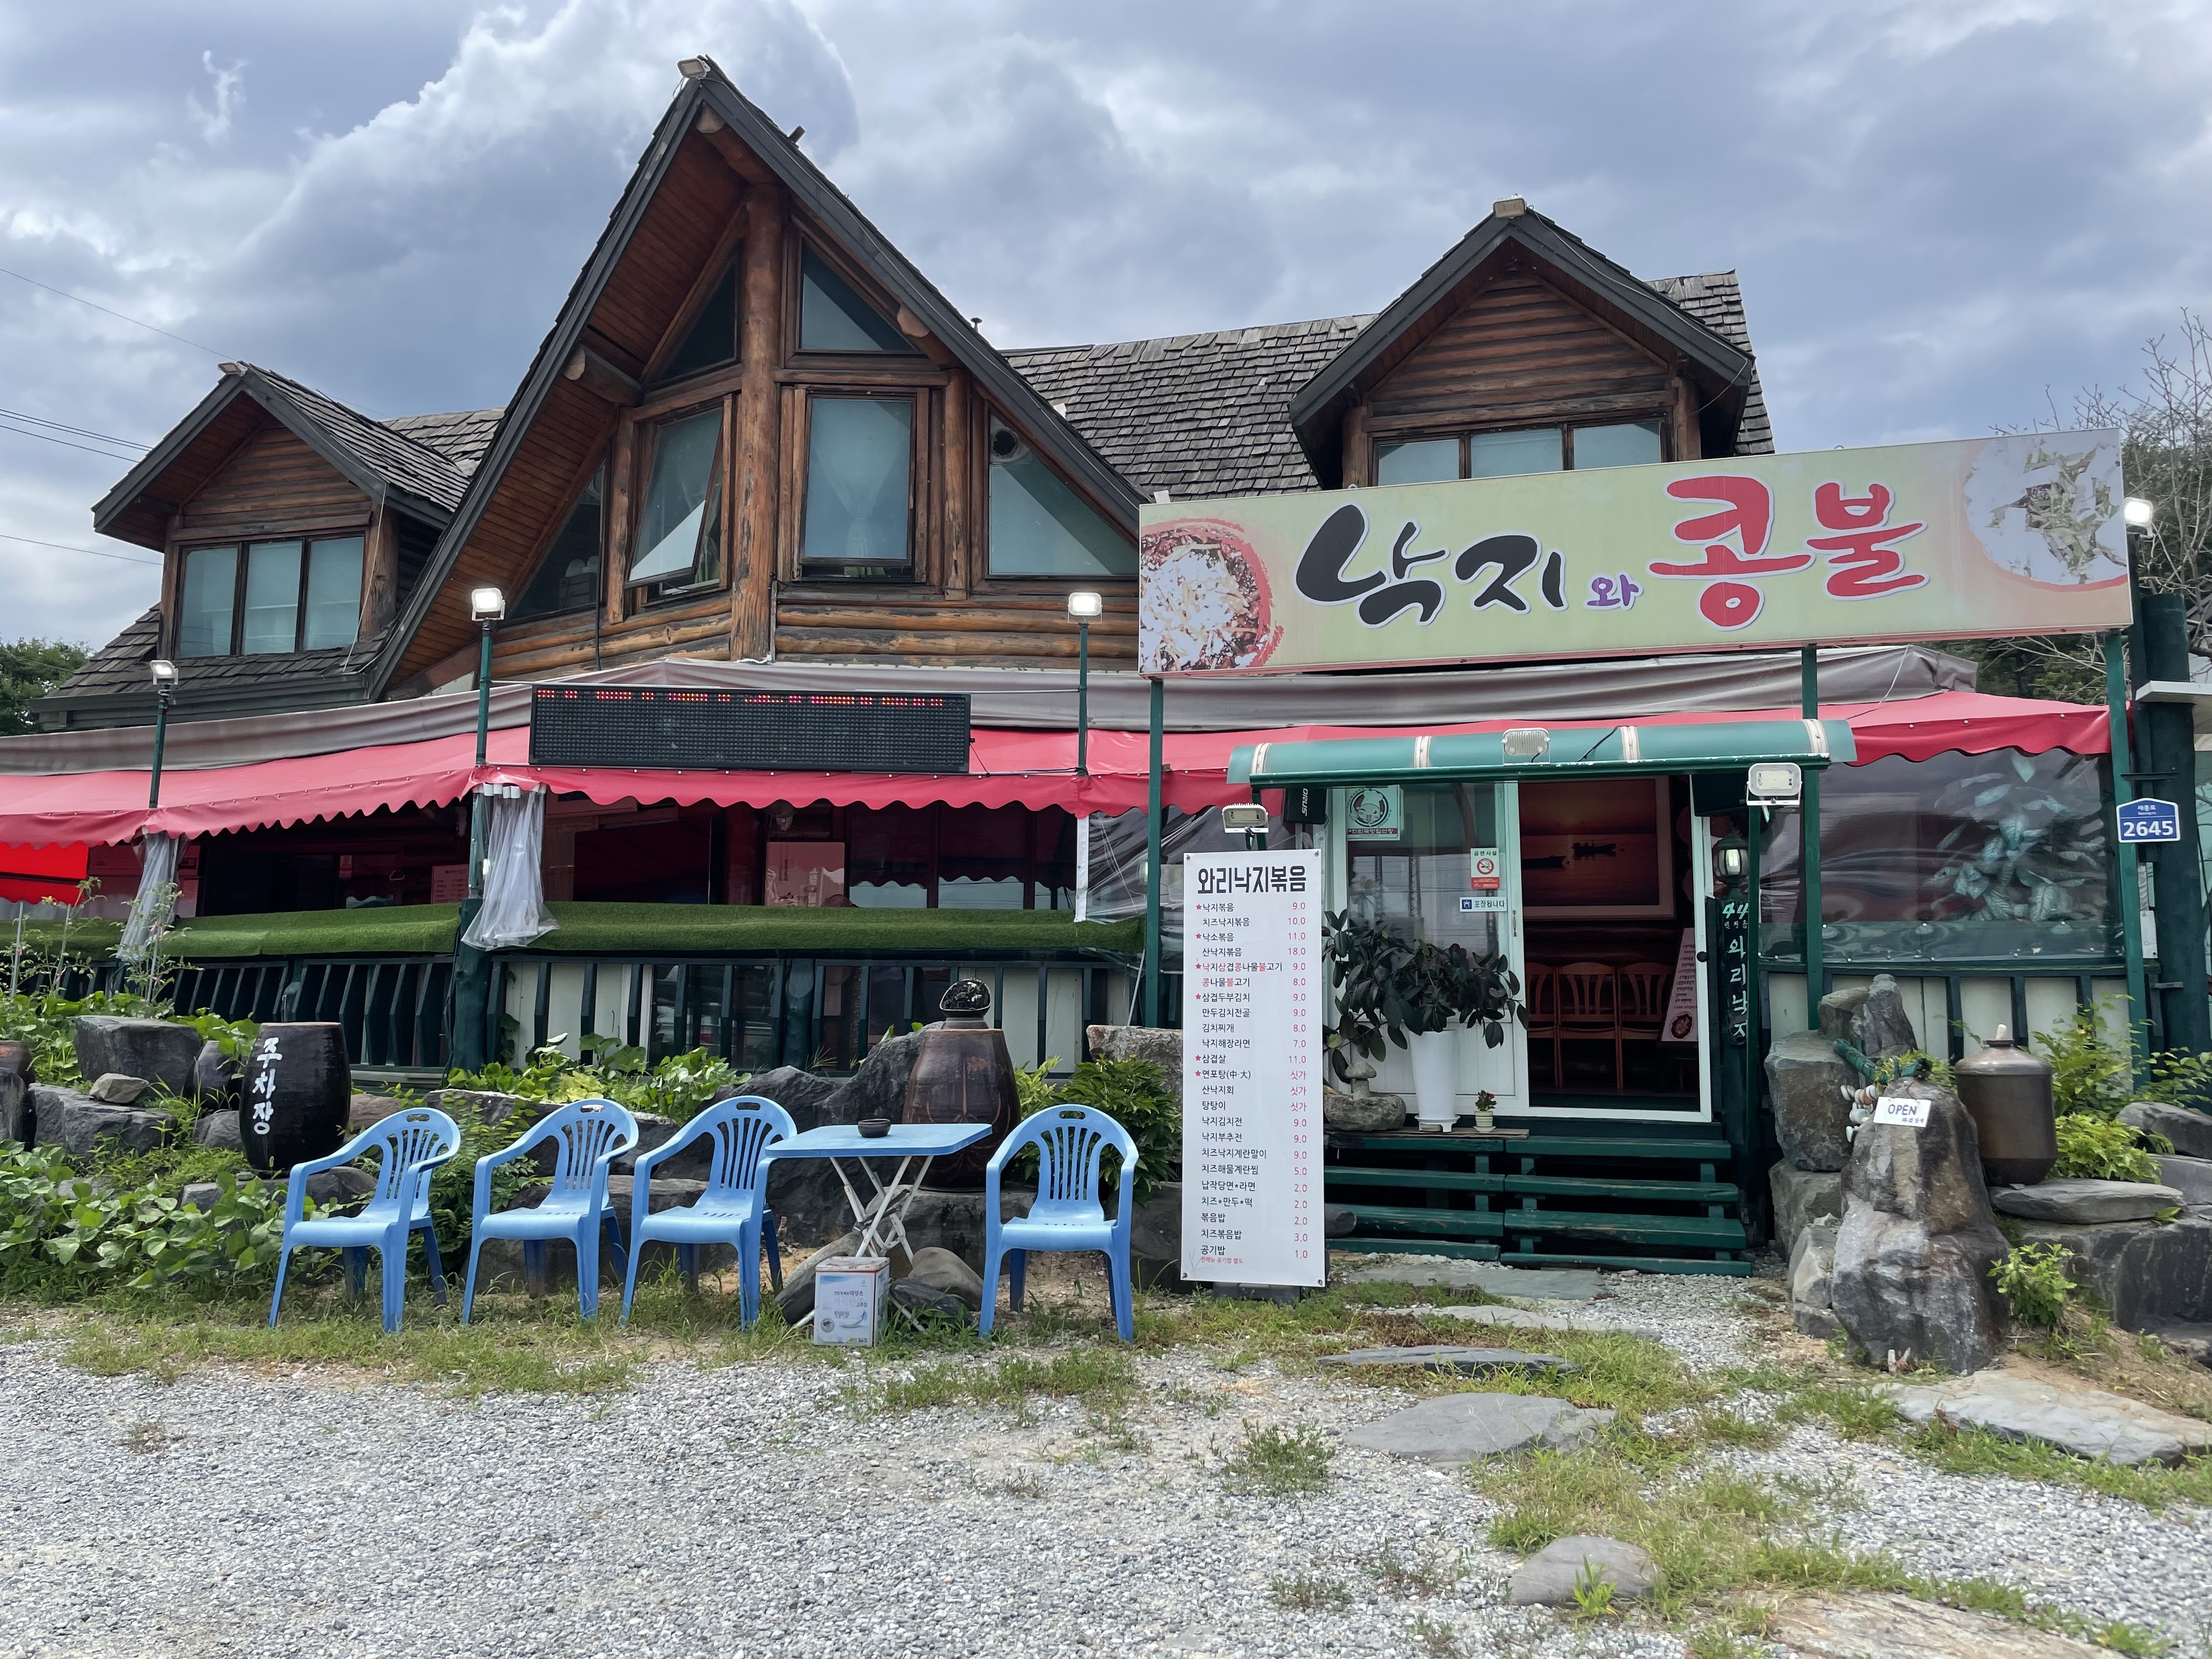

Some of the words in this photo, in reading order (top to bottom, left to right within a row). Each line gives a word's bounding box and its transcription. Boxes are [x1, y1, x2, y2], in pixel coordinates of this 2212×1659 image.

[1295, 504, 1565, 625] 낙지
[1587, 574, 1639, 607] 와
[1649, 475, 1925, 627] 콩불
[2123, 820, 2174, 837] 2645
[1198, 865, 1307, 894] 와리낙지볶음
[1203, 903, 1234, 912] 낙지볶음
[1474, 900, 1505, 908] 포장됩니다
[1722, 902, 1749, 919] 44
[1203, 918, 1250, 927] 치즈낙지볶음
[1203, 933, 1234, 942] 낙소볶음
[1203, 948, 1242, 957] 산낙지볶음
[1203, 962, 1282, 972] 낙지삼겹콩나물불고기
[1203, 978, 1250, 987] 콩나물불고기
[1728, 935, 1748, 1037] 와리낙지
[1202, 993, 1250, 1002] 삼겹두부김치
[1202, 1008, 1250, 1017] 만두김치전골
[1202, 1024, 1234, 1032] 김치찌개
[1202, 1039, 1250, 1048] 낙지해장라면
[1202, 1054, 1226, 1064] 삼겹살
[1289, 1056, 1306, 1064] 11.0
[1291, 1070, 1306, 1080] 싯가
[252, 1036, 283, 1135] 주차장
[1201, 1085, 1234, 1094] 산낙지회
[1291, 1086, 1306, 1096] 싯가
[1201, 1101, 1226, 1110] 탕탕이
[1291, 1102, 1307, 1111] 싯가
[1888, 1104, 1917, 1115] OPEN
[1201, 1116, 1242, 1126] 낙지김치전
[1201, 1132, 1242, 1142] 낙지부추전
[1294, 1135, 1306, 1143] 9.0
[1201, 1148, 1266, 1159] 치즈낙지계란말이
[1294, 1151, 1307, 1159] 9.0
[1201, 1164, 1259, 1175] 치즈해물계란찜
[1295, 1167, 1307, 1176] 5.0
[1295, 1184, 1307, 1192] 2.0
[1295, 1200, 1307, 1209] 2.0
[1201, 1213, 1226, 1223] 볶음밥
[1295, 1217, 1307, 1225] 2.0
[1201, 1229, 1242, 1240] 치즈볶음밥
[1295, 1233, 1307, 1242] 3.0
[1200, 1245, 1226, 1255] 공기밥
[1295, 1250, 1307, 1259] 1.0
